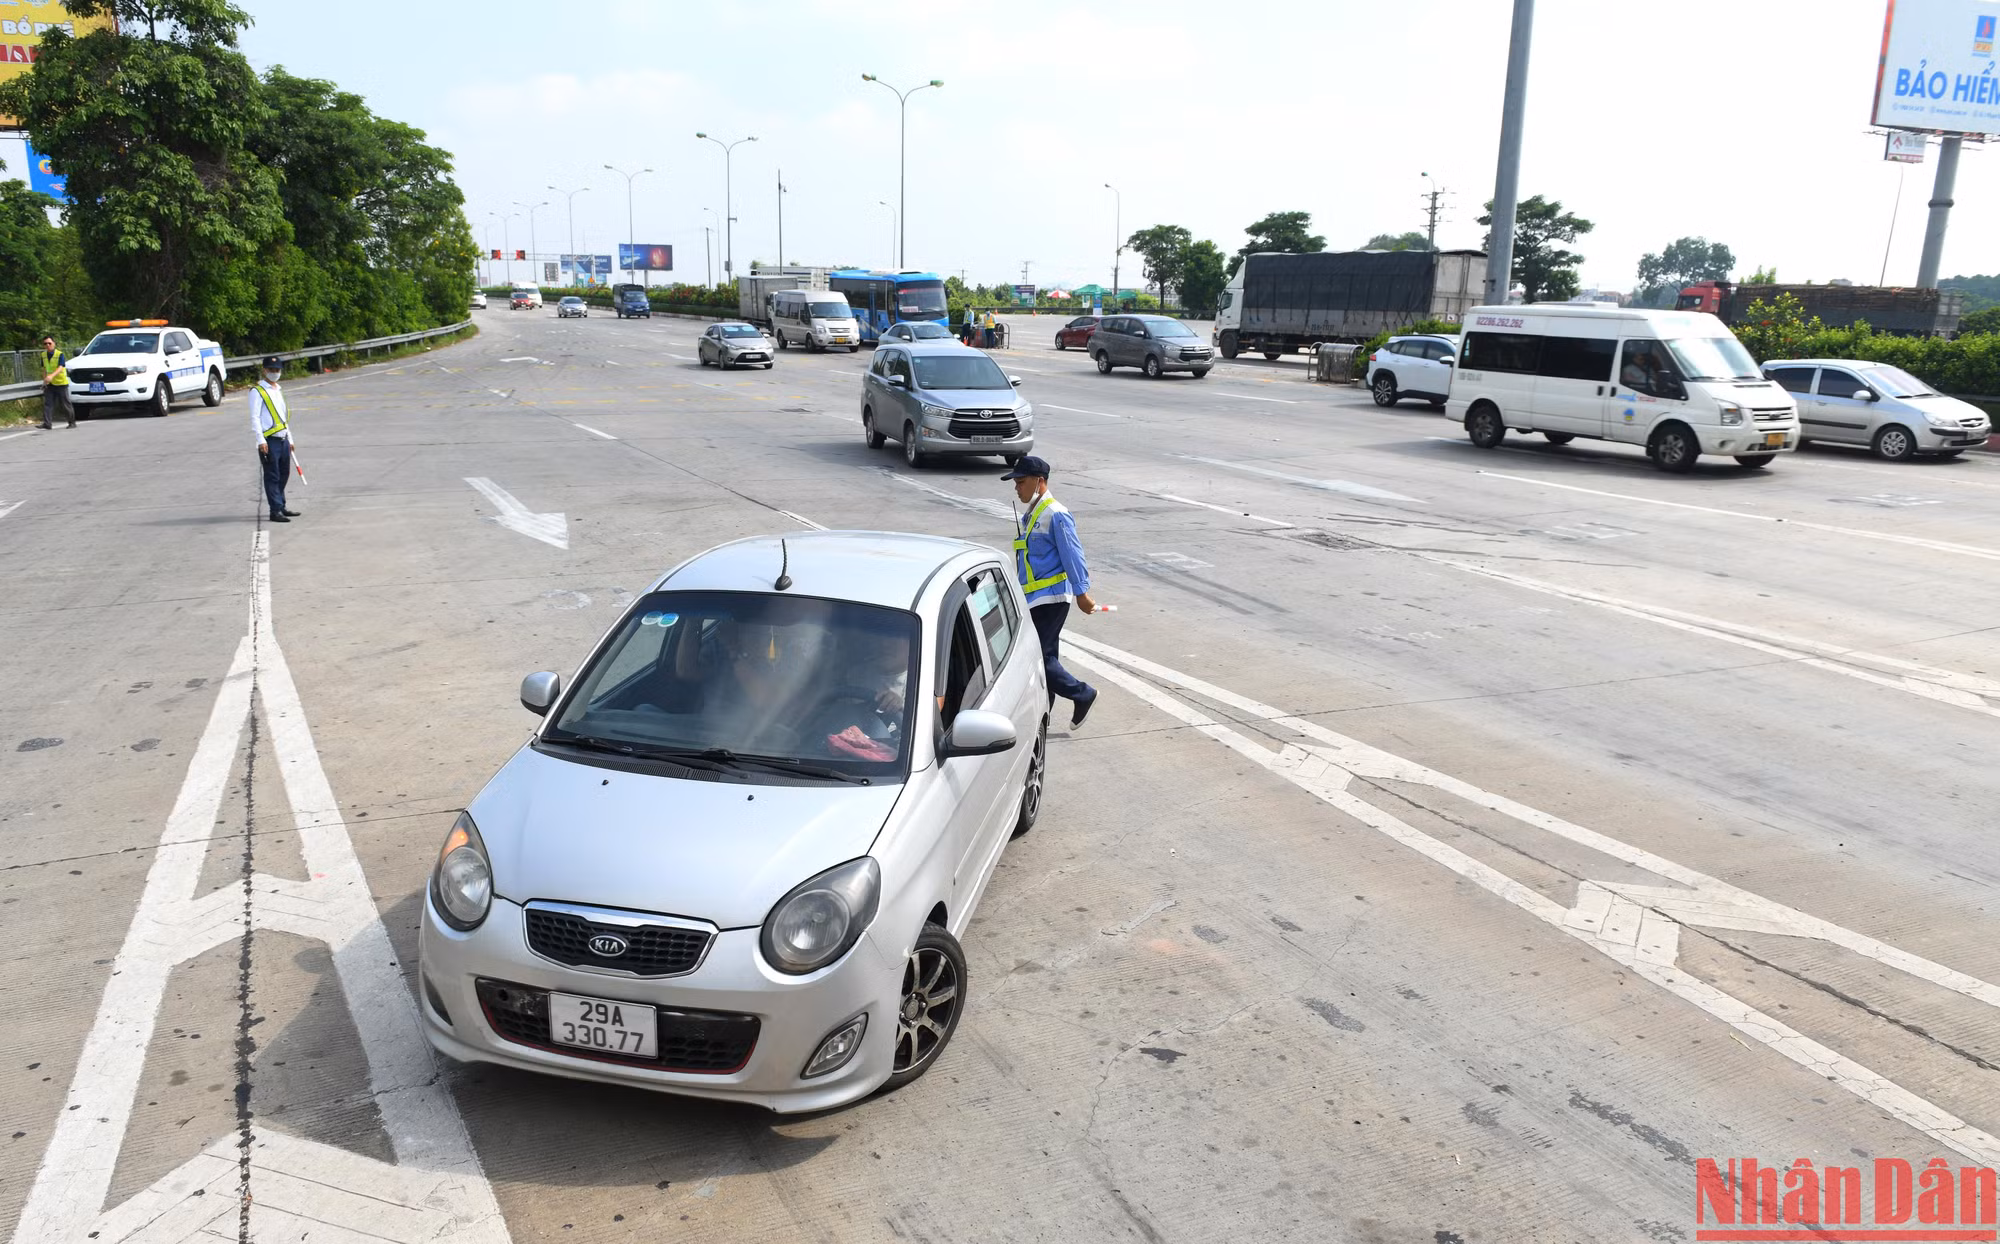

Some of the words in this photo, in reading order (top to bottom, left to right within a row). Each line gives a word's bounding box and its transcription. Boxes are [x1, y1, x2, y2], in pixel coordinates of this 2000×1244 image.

[1895, 59, 1948, 99] BẢO
[594, 938, 620, 953] KIA
[579, 1001, 624, 1028] 29A
[562, 1021, 644, 1053] 330.77
